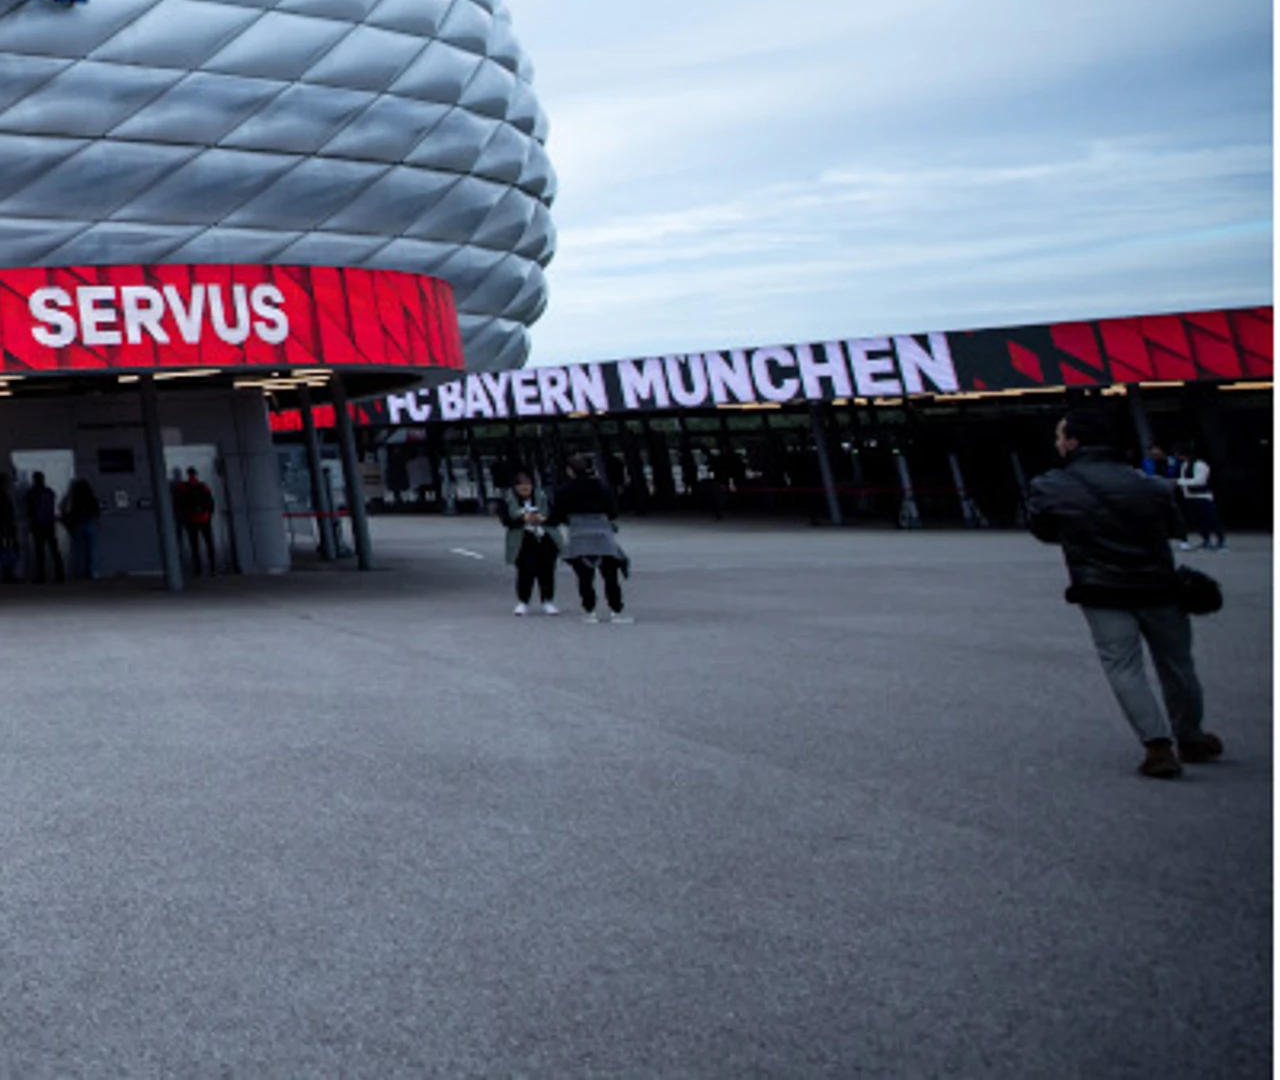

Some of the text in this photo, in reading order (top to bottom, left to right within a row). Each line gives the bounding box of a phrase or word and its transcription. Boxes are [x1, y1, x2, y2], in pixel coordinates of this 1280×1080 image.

[29, 282, 290, 349] SERVUS
[386, 388, 432, 424] FC
[438, 363, 610, 421] BAYERN
